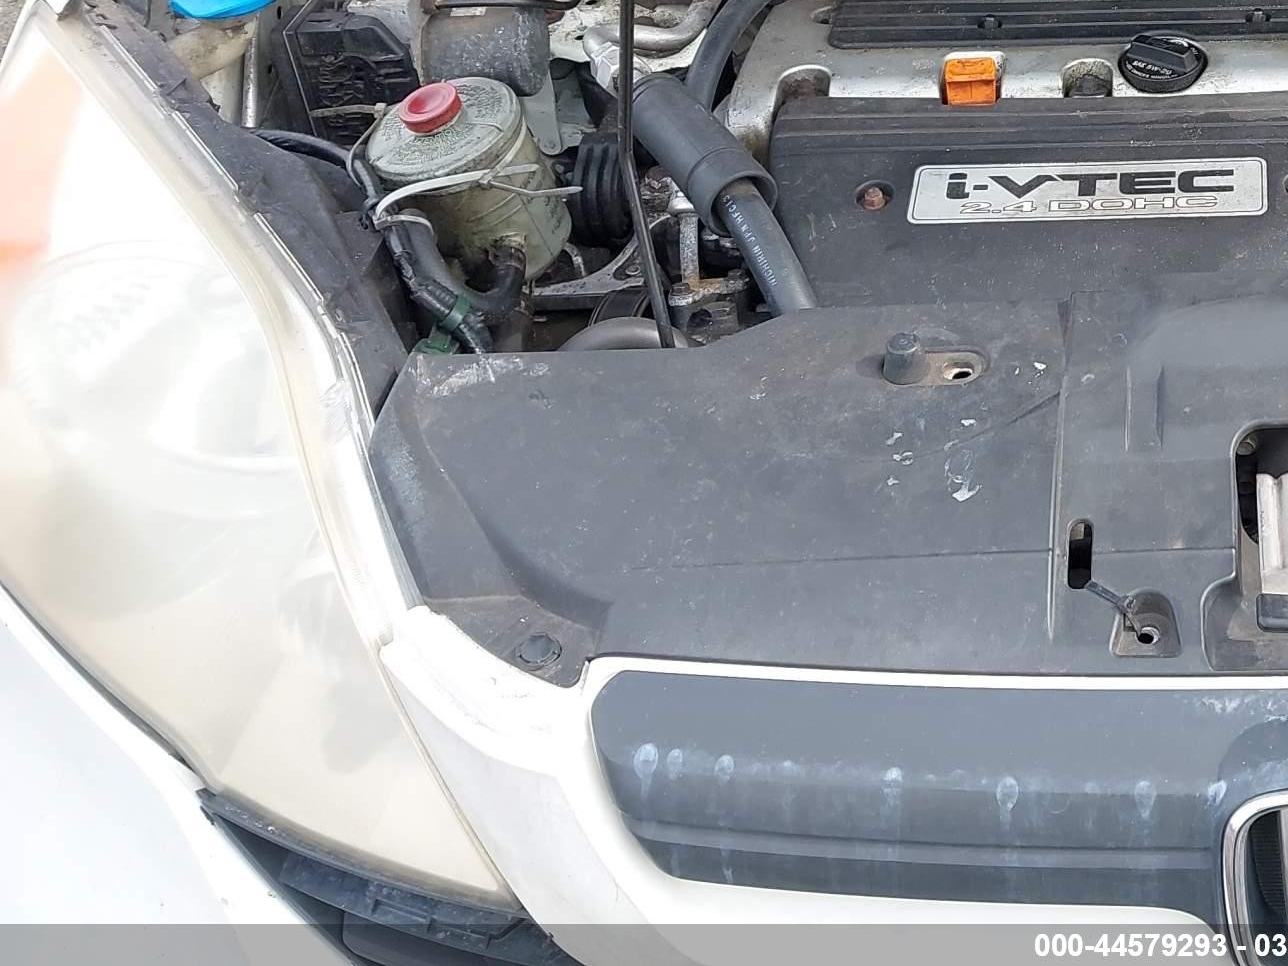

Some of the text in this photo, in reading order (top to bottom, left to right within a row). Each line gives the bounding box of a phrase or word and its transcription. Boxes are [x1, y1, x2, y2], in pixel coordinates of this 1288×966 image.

[945, 168, 1235, 200] i-VTEC
[959, 195, 1219, 215] 2.4 DOHC
